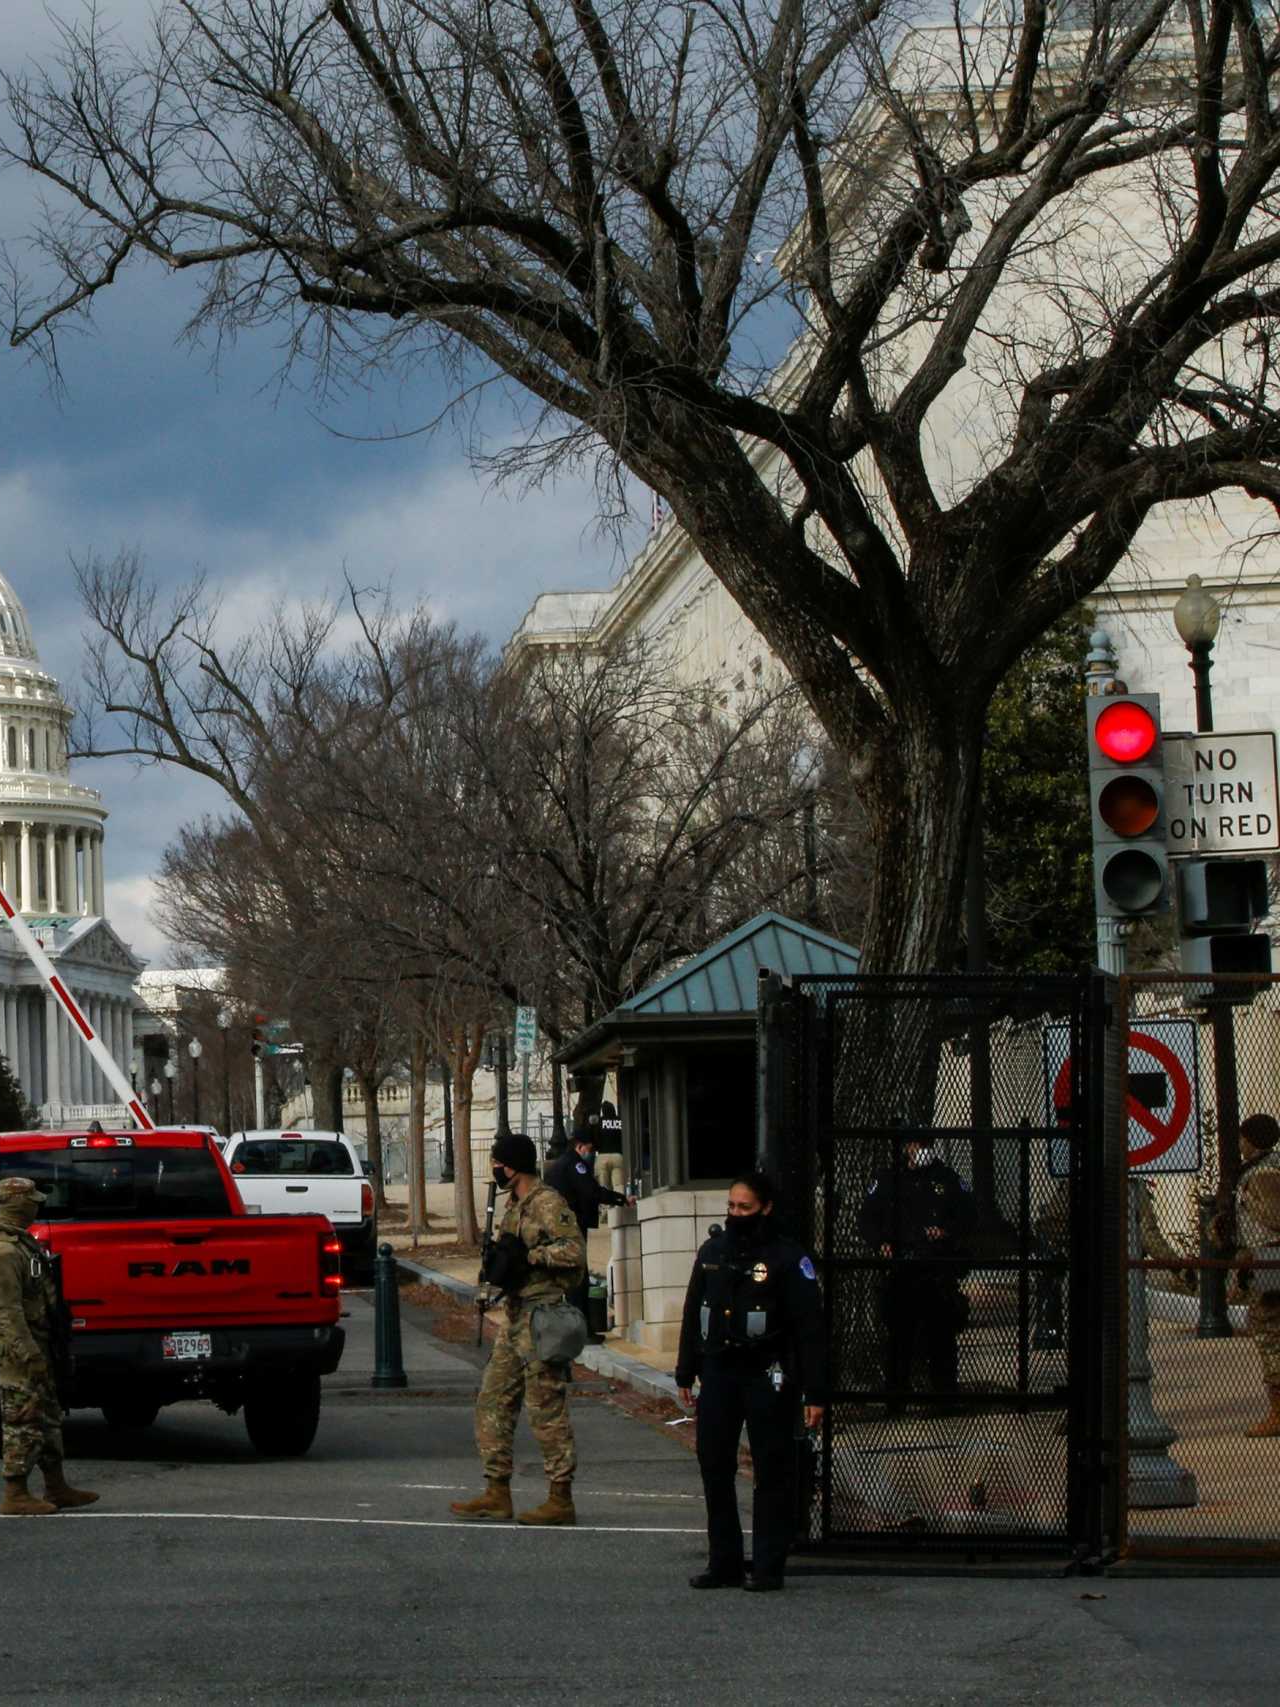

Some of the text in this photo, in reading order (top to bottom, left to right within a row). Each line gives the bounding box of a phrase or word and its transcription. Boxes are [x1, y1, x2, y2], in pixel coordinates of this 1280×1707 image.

[1195, 748, 1237, 771] NO
[1183, 781, 1254, 805] TURN
[1171, 814, 1272, 839] ON RED
[602, 1119, 623, 1130] POLICE
[127, 1259, 251, 1278] RAM
